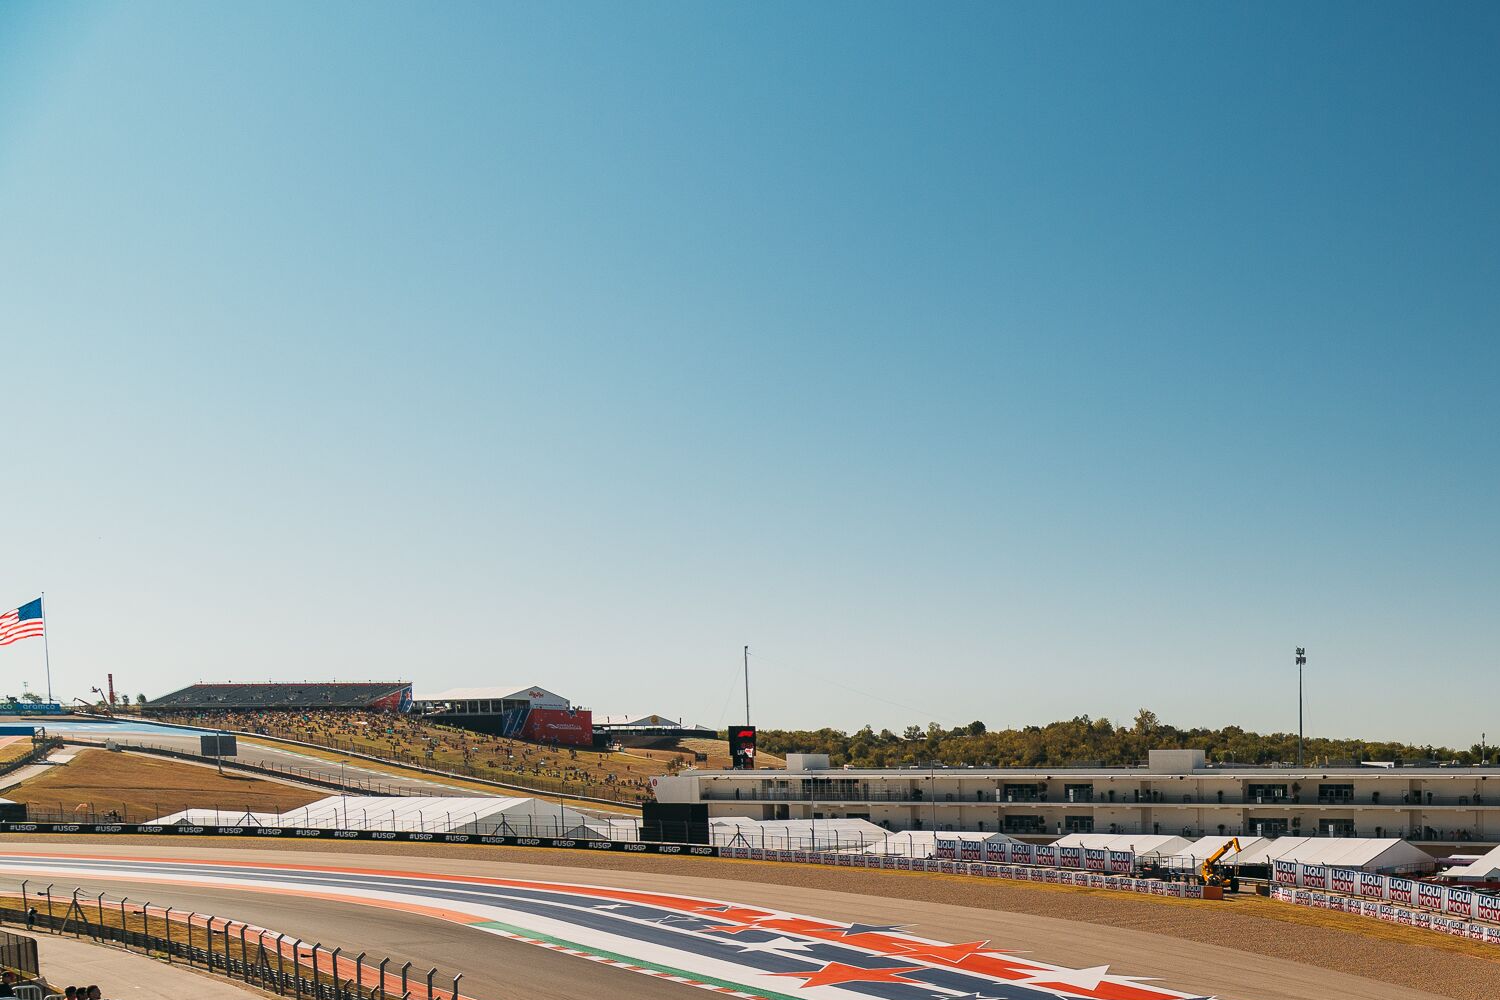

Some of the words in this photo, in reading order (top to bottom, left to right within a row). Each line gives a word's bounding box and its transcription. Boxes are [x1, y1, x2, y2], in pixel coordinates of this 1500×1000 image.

[938, 841, 955, 849] LIQUI
[962, 842, 980, 850] LIQUI
[988, 843, 1005, 852] LIQUI
[1012, 844, 1030, 853] LIQUI
[962, 850, 980, 859] MOLY
[1037, 846, 1054, 855] LIQUI
[1061, 848, 1079, 857] LIQUI
[1086, 850, 1104, 859] LIQUI
[988, 852, 1005, 861] MOLY
[1012, 854, 1030, 863] MOLY
[1037, 856, 1054, 865] MOLY
[1111, 852, 1129, 861] LIQUI
[1061, 858, 1079, 867] MOLY
[1086, 859, 1104, 868] MOLY
[1111, 862, 1129, 871] MOLY
[1276, 861, 1295, 872] LIQUI
[1304, 866, 1324, 877] LIQUI
[1332, 870, 1353, 881] LIQUI
[1276, 872, 1295, 883] MOLY
[1304, 877, 1324, 887] MOLY
[1362, 874, 1381, 886] LIQUI
[1332, 881, 1353, 891] MOLY
[1390, 878, 1411, 890] LIQUI
[1362, 885, 1381, 896] MOLY
[1419, 884, 1440, 896] LIQUI
[1390, 890, 1411, 902] MOLY
[1449, 889, 1470, 902] LIQUI
[1419, 895, 1440, 908] MOLY
[1479, 896, 1500, 908] LIQUI
[1449, 901, 1470, 914] MOLY
[1479, 908, 1500, 920] MOLY
